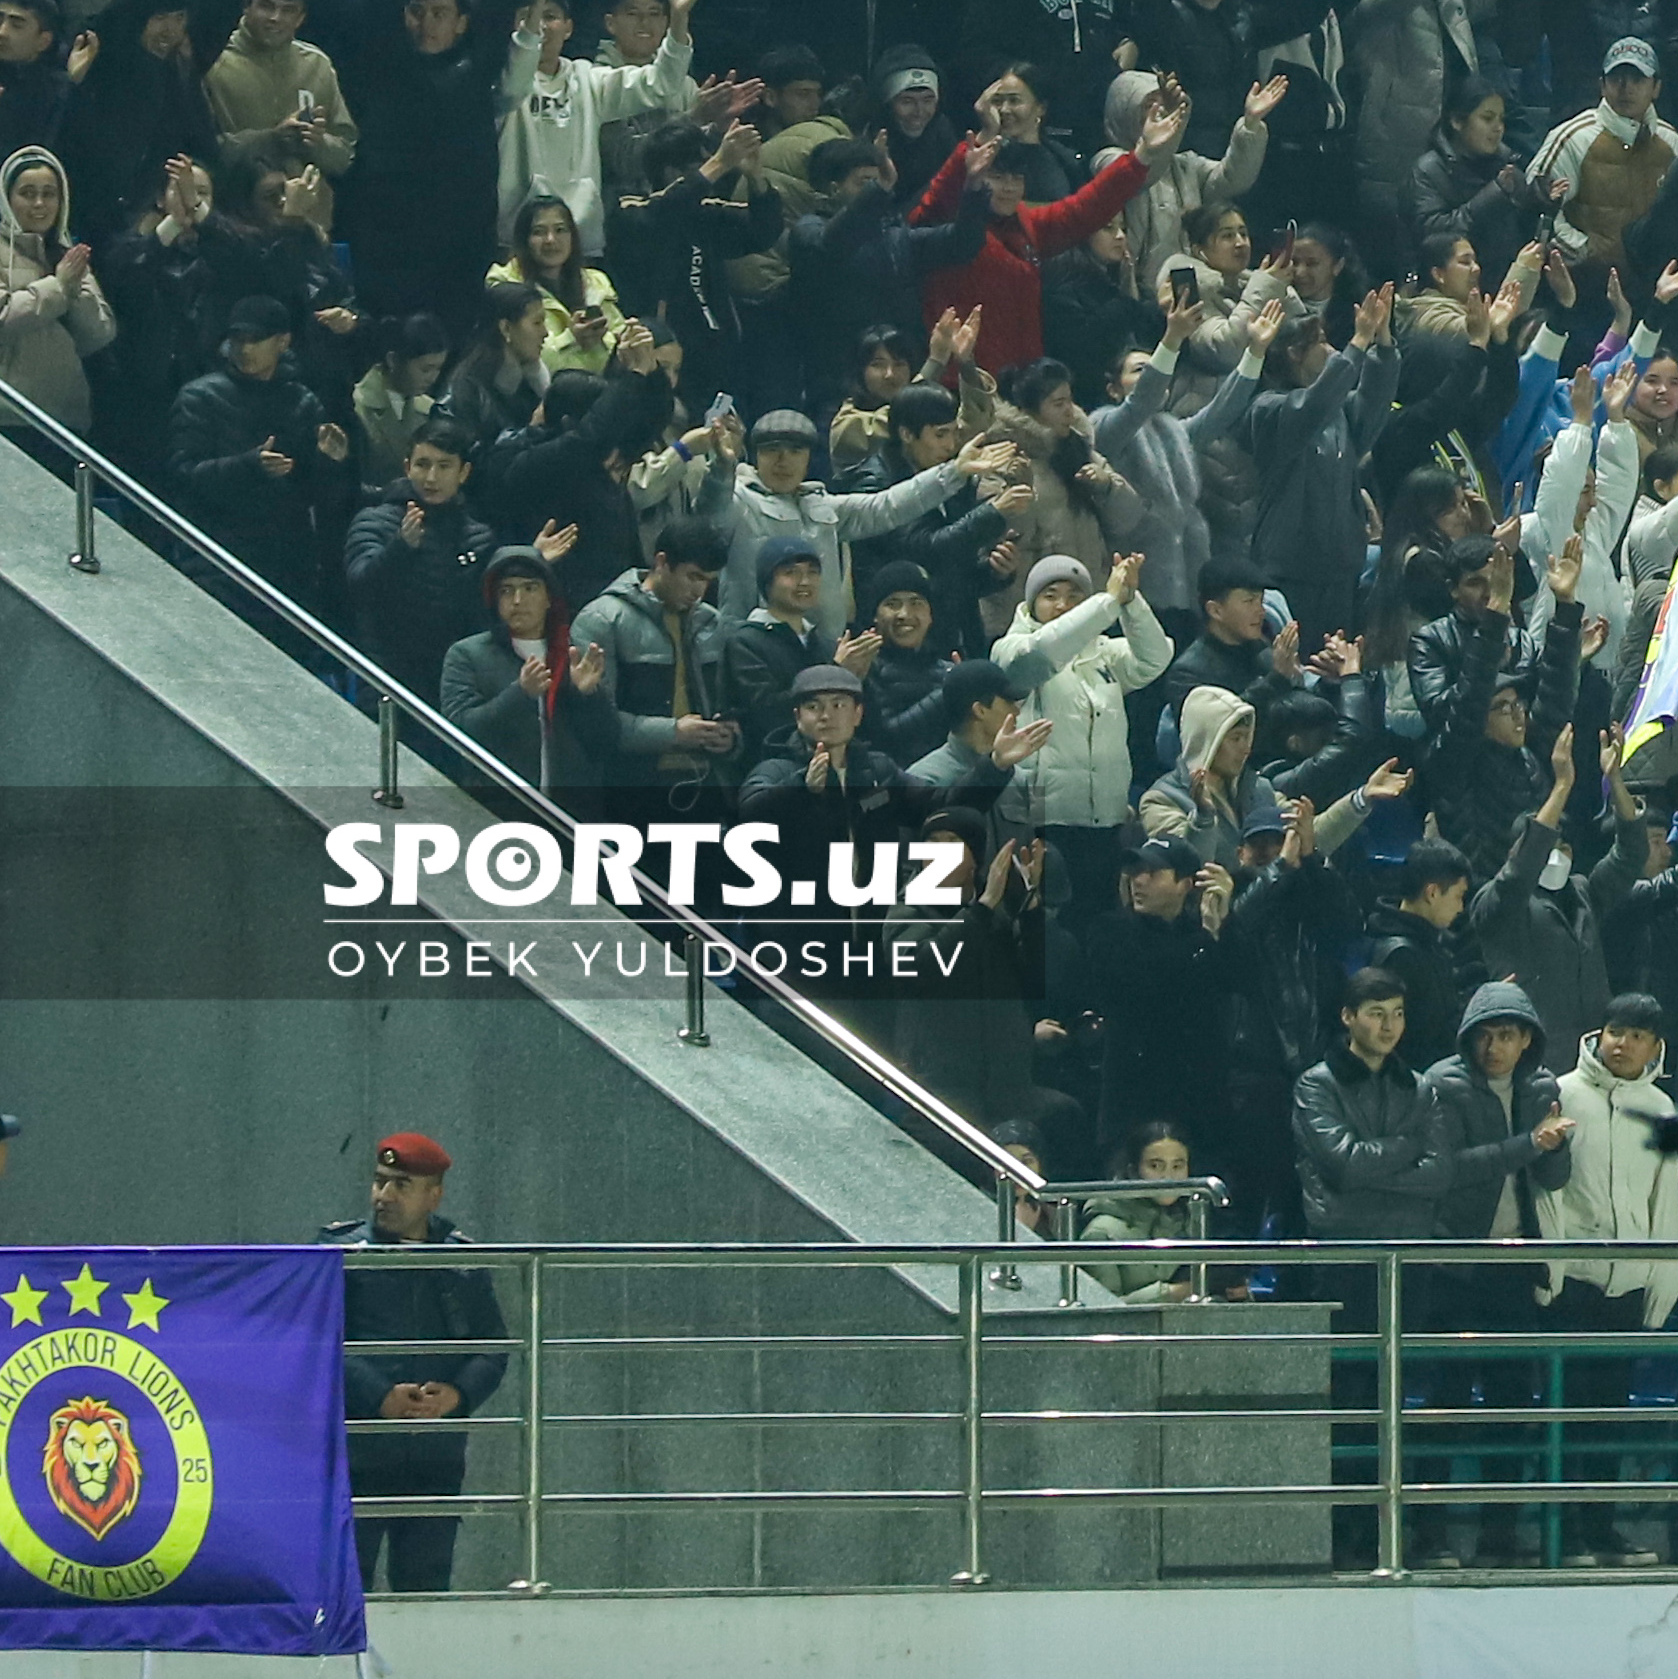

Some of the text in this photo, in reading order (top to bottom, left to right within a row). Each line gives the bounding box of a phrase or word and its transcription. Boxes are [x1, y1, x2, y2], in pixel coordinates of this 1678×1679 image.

[0, 1332, 195, 1431] AKHTAKOR LIONS
[182, 1458, 208, 1483] 25
[47, 1557, 165, 1598] FAN CLUB
